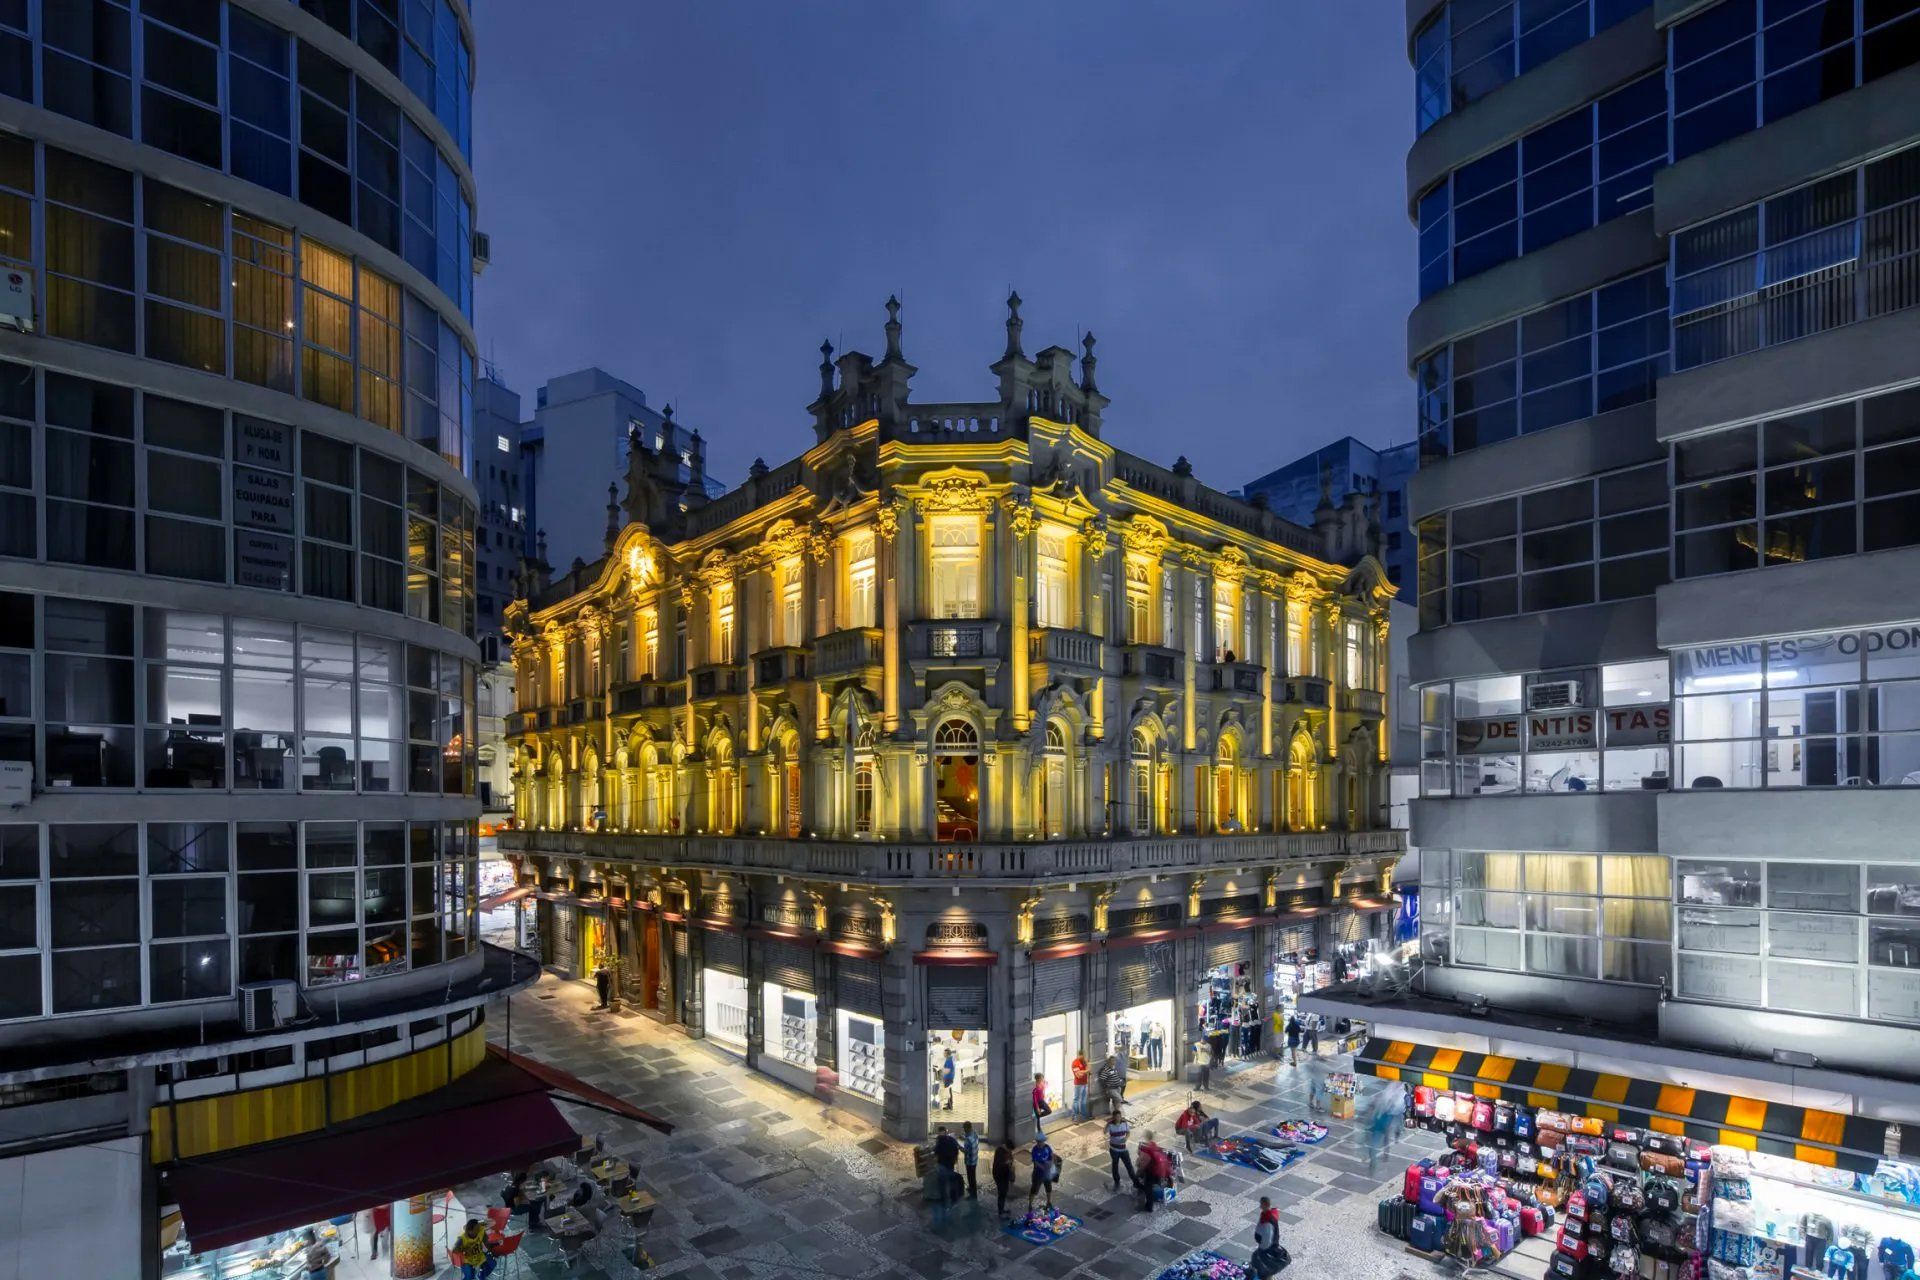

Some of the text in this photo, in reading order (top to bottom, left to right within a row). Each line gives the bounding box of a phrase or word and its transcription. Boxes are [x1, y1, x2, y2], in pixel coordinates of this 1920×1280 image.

[9, 284, 22, 293] LG
[258, 447, 281, 461] HORA
[247, 475, 279, 489] SALAS
[235, 489, 290, 508] EQUIPADAS
[251, 510, 276, 524] PARA
[1698, 640, 1799, 668] MENDES
